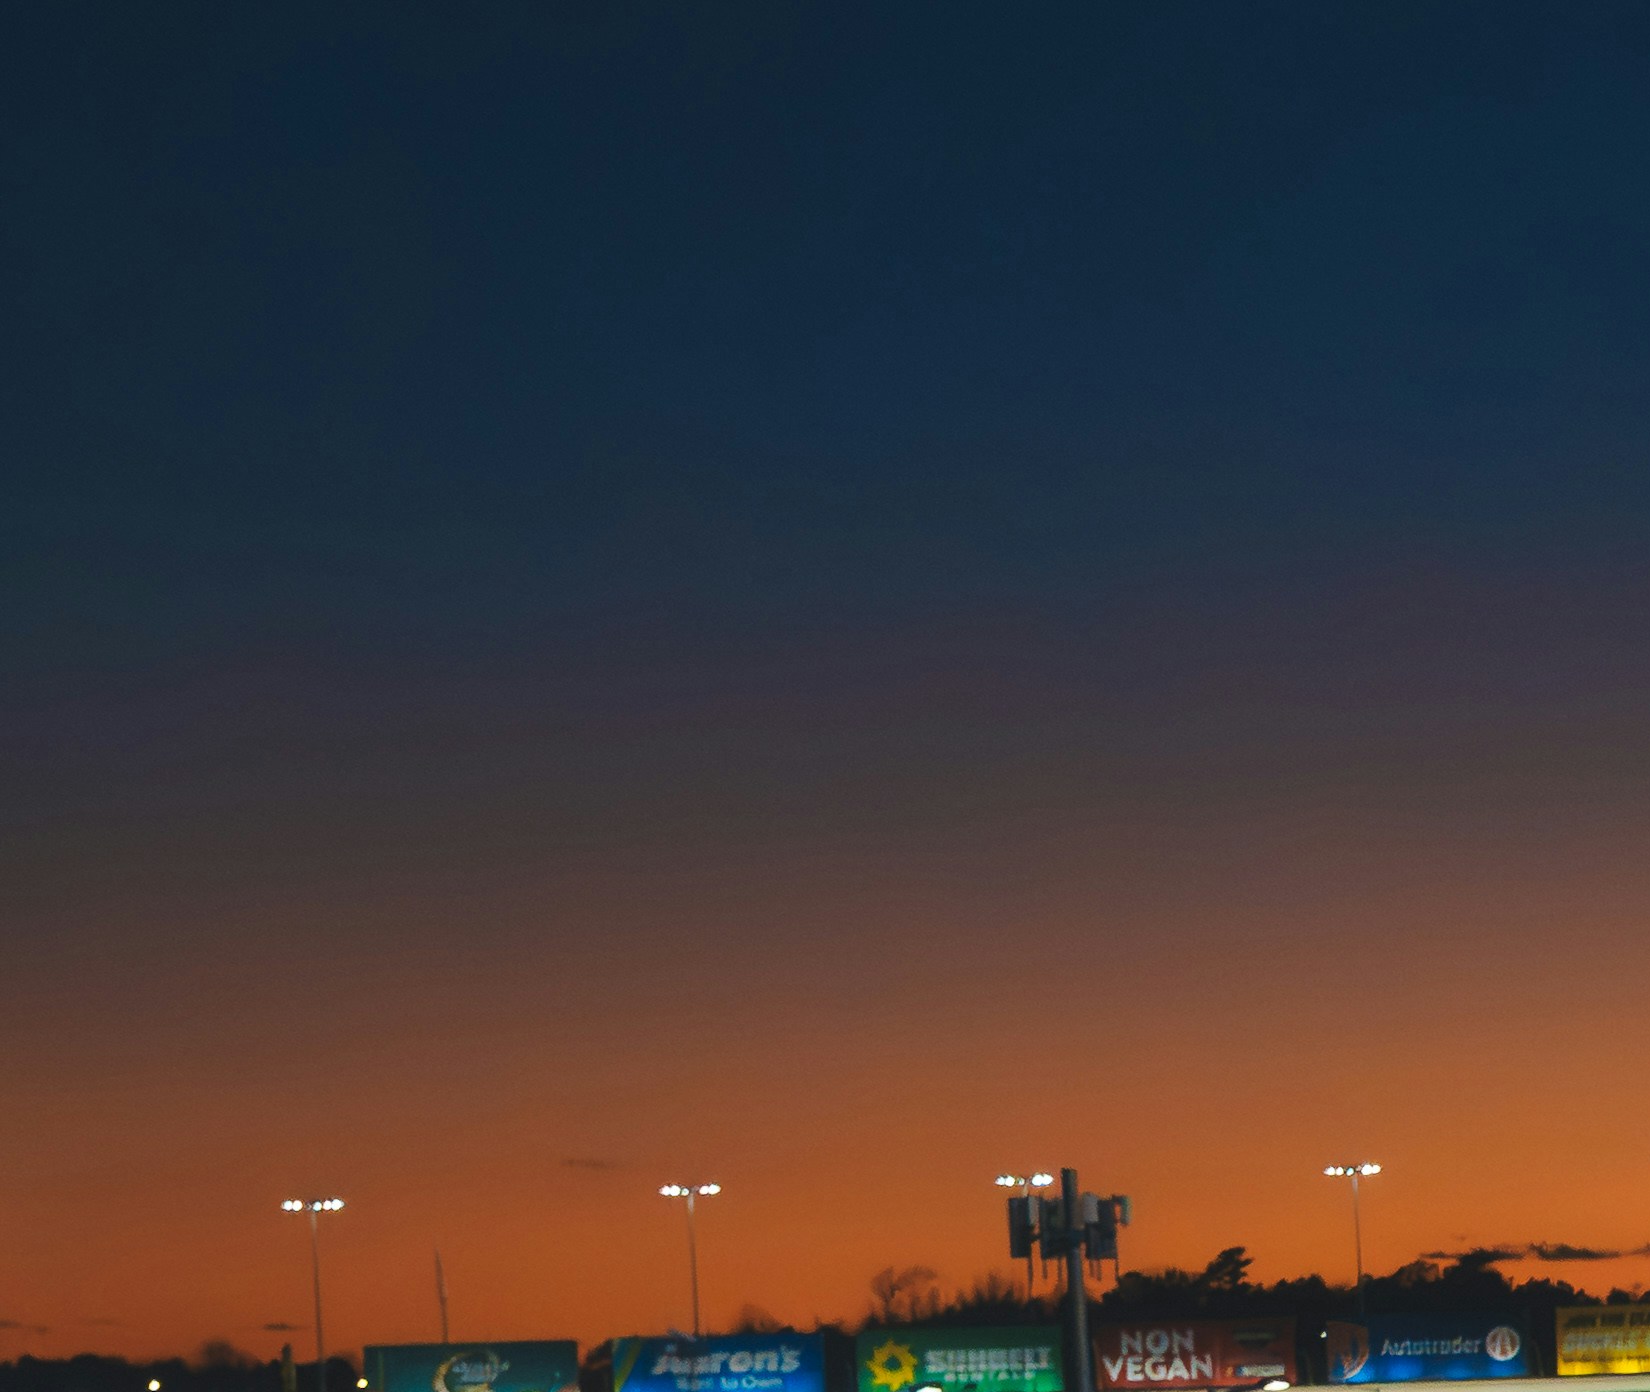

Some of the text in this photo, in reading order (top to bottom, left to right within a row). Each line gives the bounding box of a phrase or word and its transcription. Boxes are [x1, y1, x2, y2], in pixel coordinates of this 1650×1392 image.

[1120, 1330, 1195, 1355] NON
[1381, 1337, 1483, 1357] Autotrader
[651, 1345, 801, 1376] Aaron's
[1102, 1354, 1213, 1382] VEGAN
